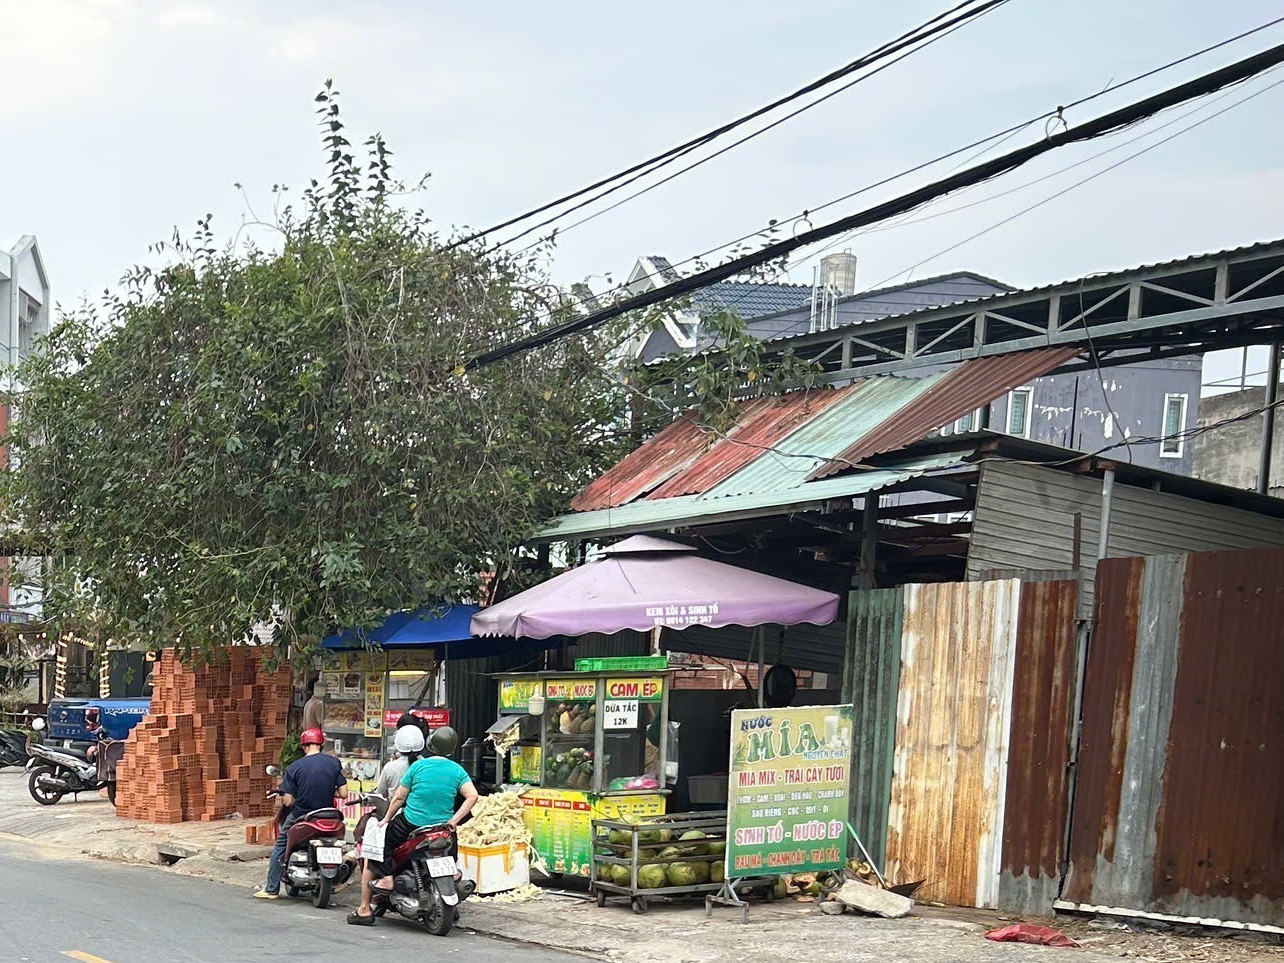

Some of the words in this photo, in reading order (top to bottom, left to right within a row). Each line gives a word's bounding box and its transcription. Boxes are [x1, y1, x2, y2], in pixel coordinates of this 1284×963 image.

[610, 682, 639, 698] CAM
[642, 680, 659, 696] ÉP
[613, 717, 627, 726] 12K
[741, 716, 772, 731] NƯỚC
[746, 719, 820, 764] MÍA
[806, 764, 822, 783] CÂY
[825, 765, 844, 782] TƯƠI
[735, 826, 765, 846] SINH
[767, 820, 783, 843] TỐ
[793, 820, 826, 842] NƯỚC
[828, 819, 843, 840] ÉP
